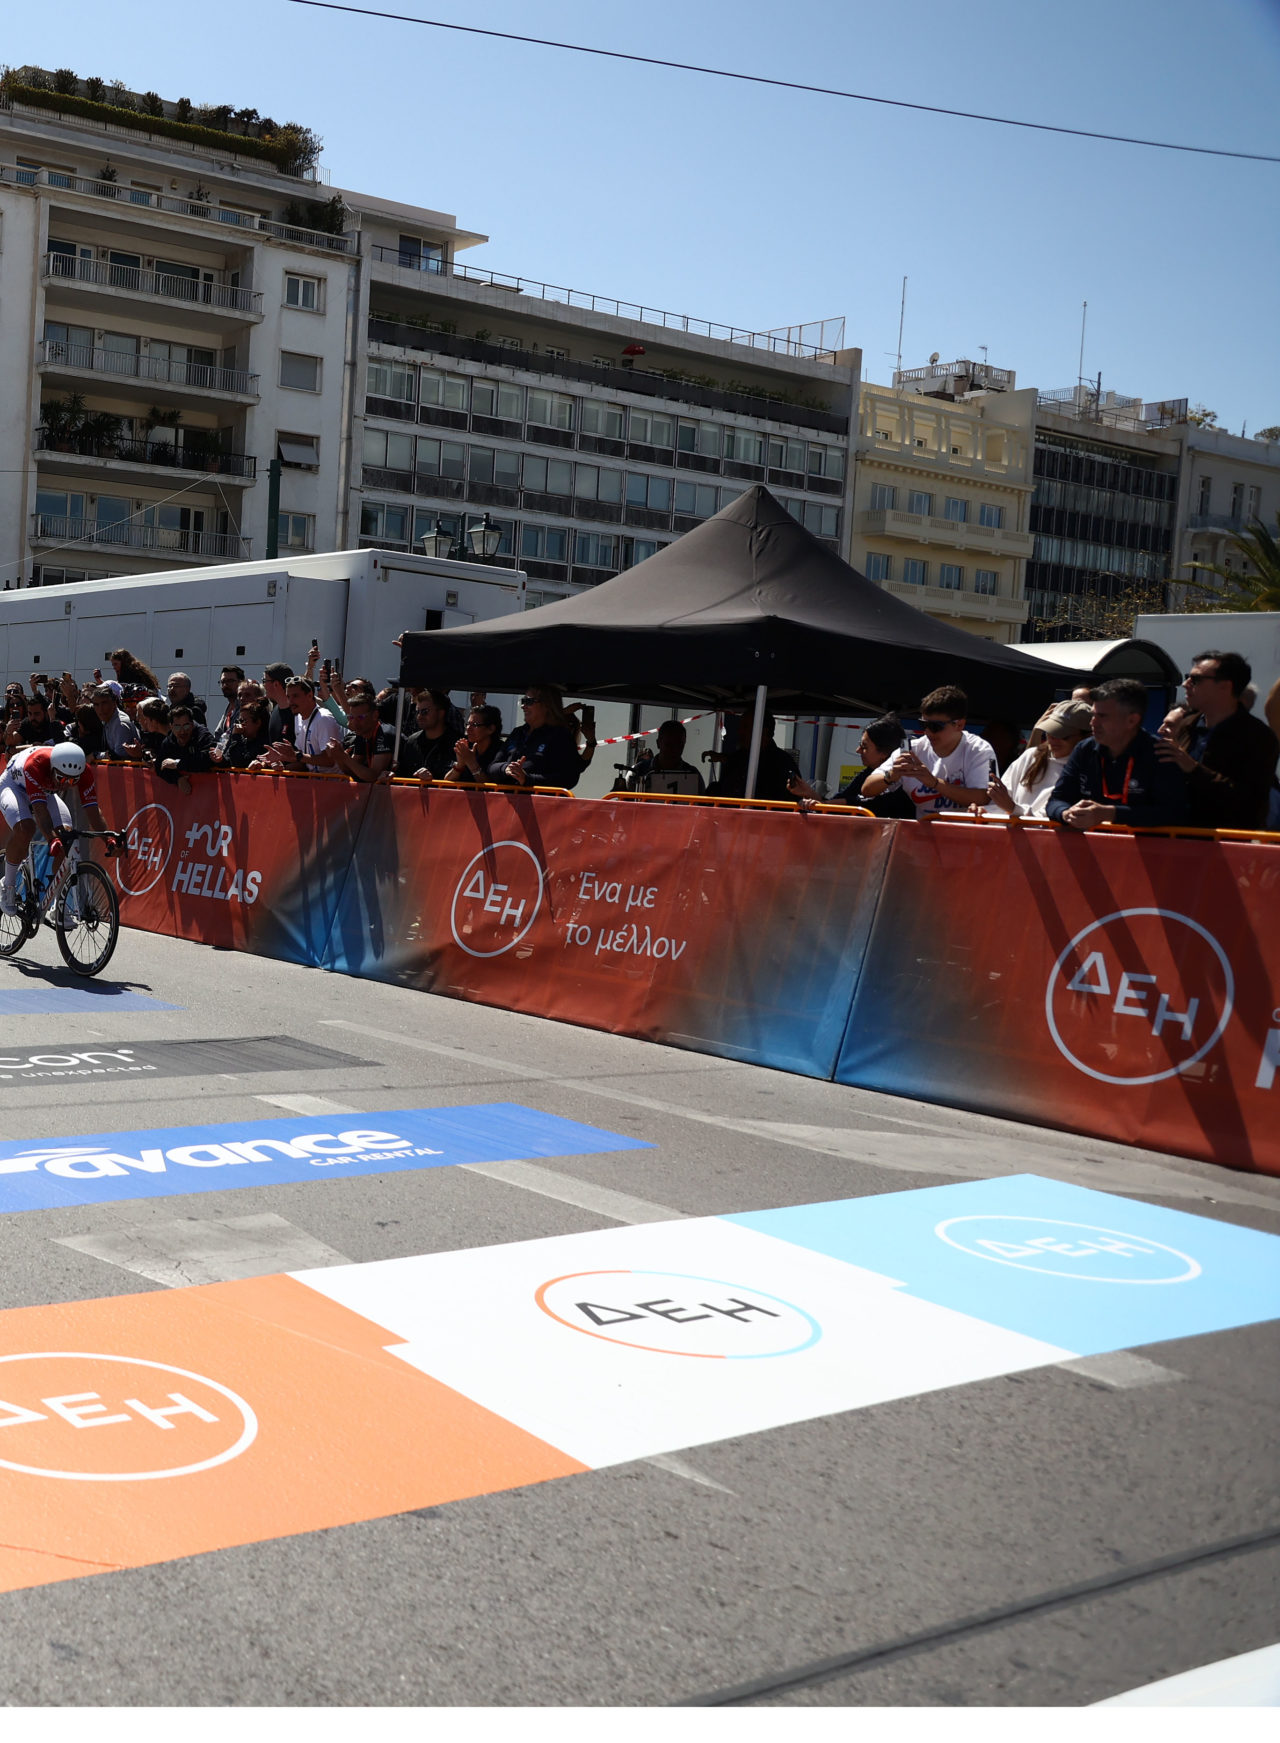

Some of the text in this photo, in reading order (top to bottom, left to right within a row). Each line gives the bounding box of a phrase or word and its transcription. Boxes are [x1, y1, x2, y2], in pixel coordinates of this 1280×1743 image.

[127, 827, 163, 871] ΔΕΗ
[180, 849, 190, 859] OF
[171, 860, 263, 904] HELLAS
[462, 869, 526, 928] ΔΕΗ
[578, 871, 659, 913] Ένα με
[565, 922, 687, 961] το μέλλον
[1065, 950, 1200, 1041] ΔΕΗ
[21, 1064, 158, 1079] unexpected
[40, 1129, 414, 1179] avance
[309, 1147, 445, 1167] CAR RENTAL
[975, 1232, 1158, 1260] ΔΕΗ
[574, 1297, 782, 1327] ΔΕΗ
